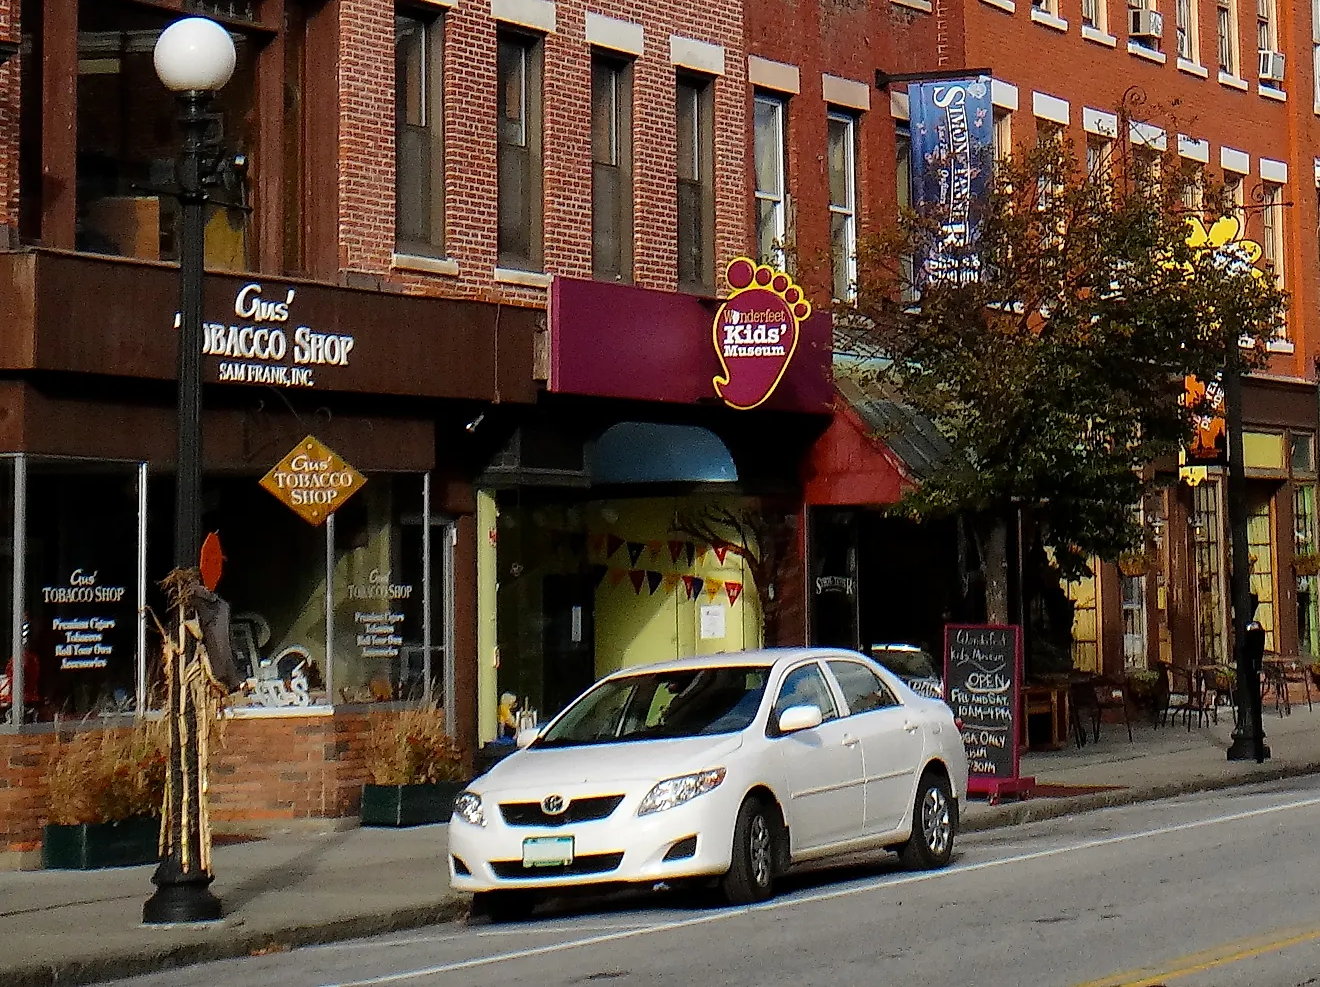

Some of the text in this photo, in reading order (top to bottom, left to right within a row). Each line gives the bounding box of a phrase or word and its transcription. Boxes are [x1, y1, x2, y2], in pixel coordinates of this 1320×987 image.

[933, 86, 969, 154] SIMON
[234, 283, 296, 322] Gus'
[173, 312, 355, 365] OBACCO SHOP
[723, 324, 787, 344] Kids'
[723, 345, 786, 357] Museum
[219, 362, 247, 381] SAM
[291, 454, 333, 472] Gus'
[274, 472, 353, 489] TOBACCO
[291, 489, 338, 505] SHOP
[42, 585, 126, 603] TOBACCO SHOP
[388, 583, 413, 599] SHOP
[53, 616, 116, 632] Premium Cigars
[968, 673, 1005, 690] OPEN
[980, 731, 1005, 748] ONLY
